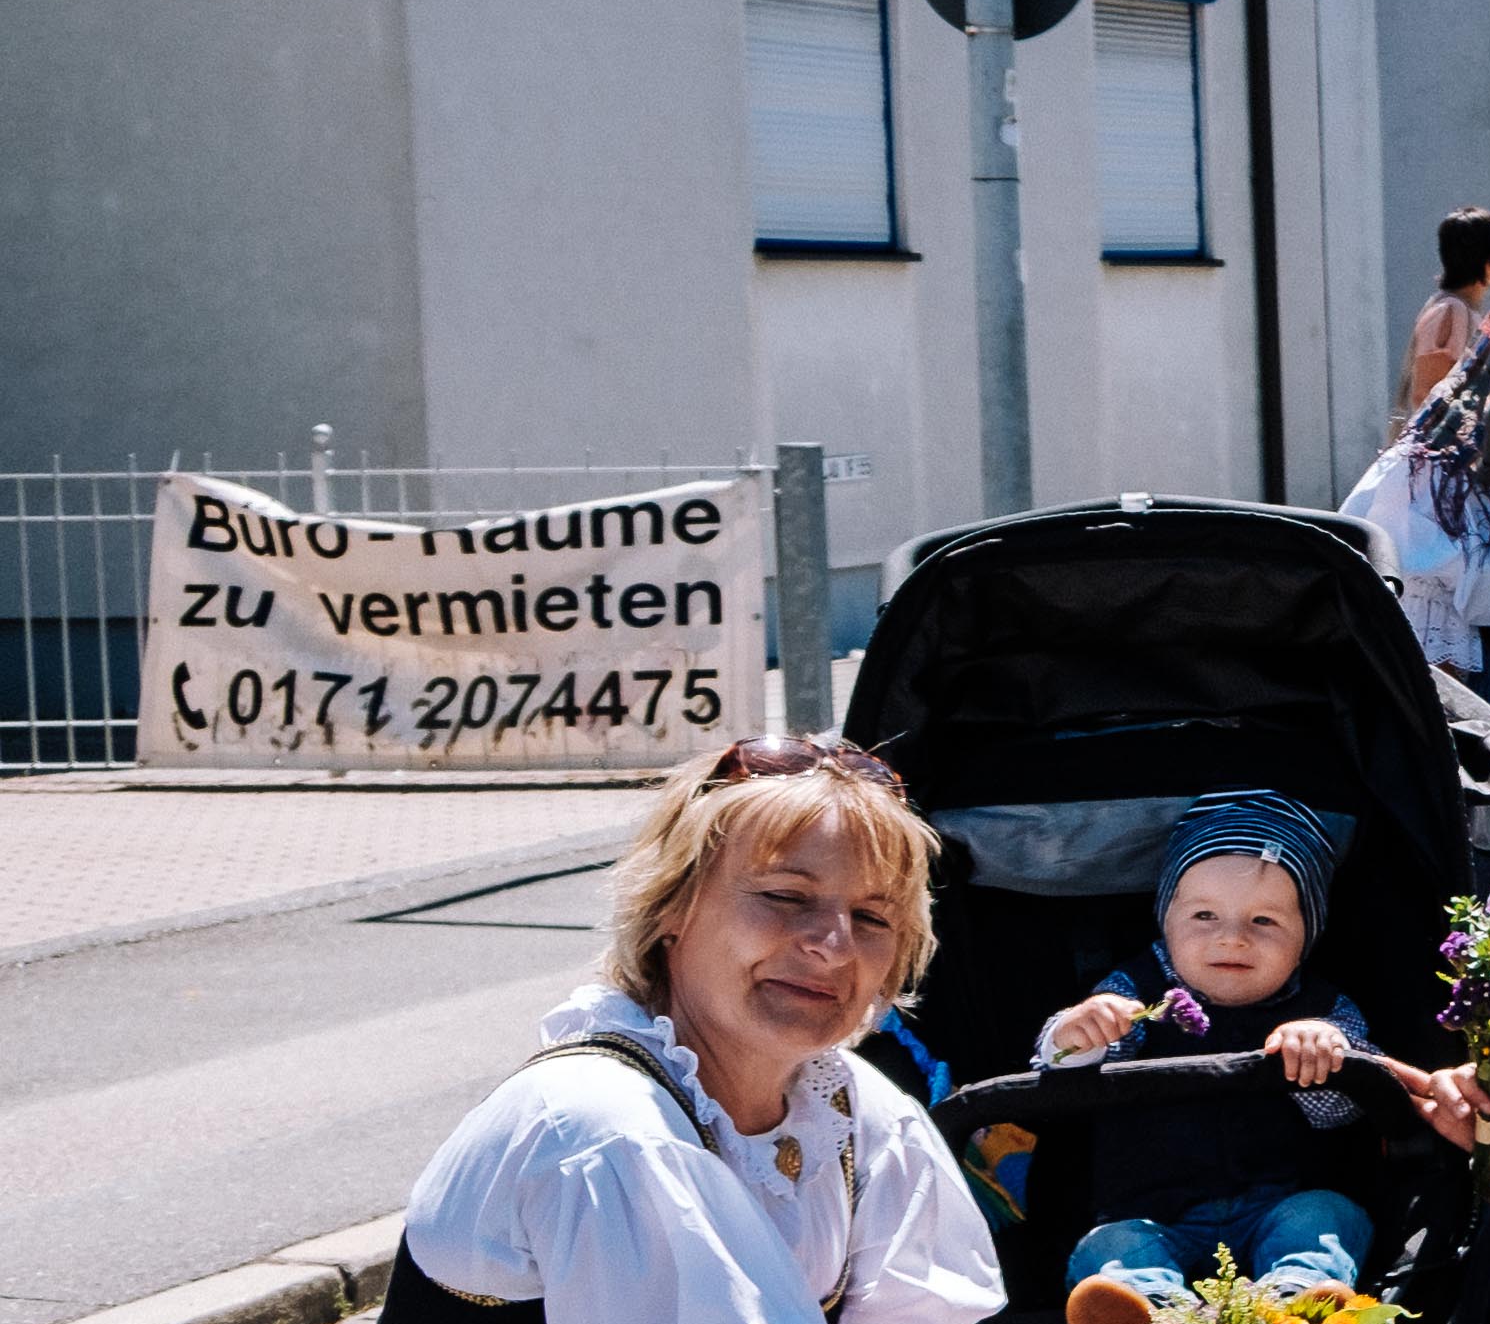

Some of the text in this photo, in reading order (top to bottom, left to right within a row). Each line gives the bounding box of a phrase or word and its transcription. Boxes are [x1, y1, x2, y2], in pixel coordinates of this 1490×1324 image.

[179, 573, 723, 636] zu vermieten
[417, 668, 722, 730] 2074475
